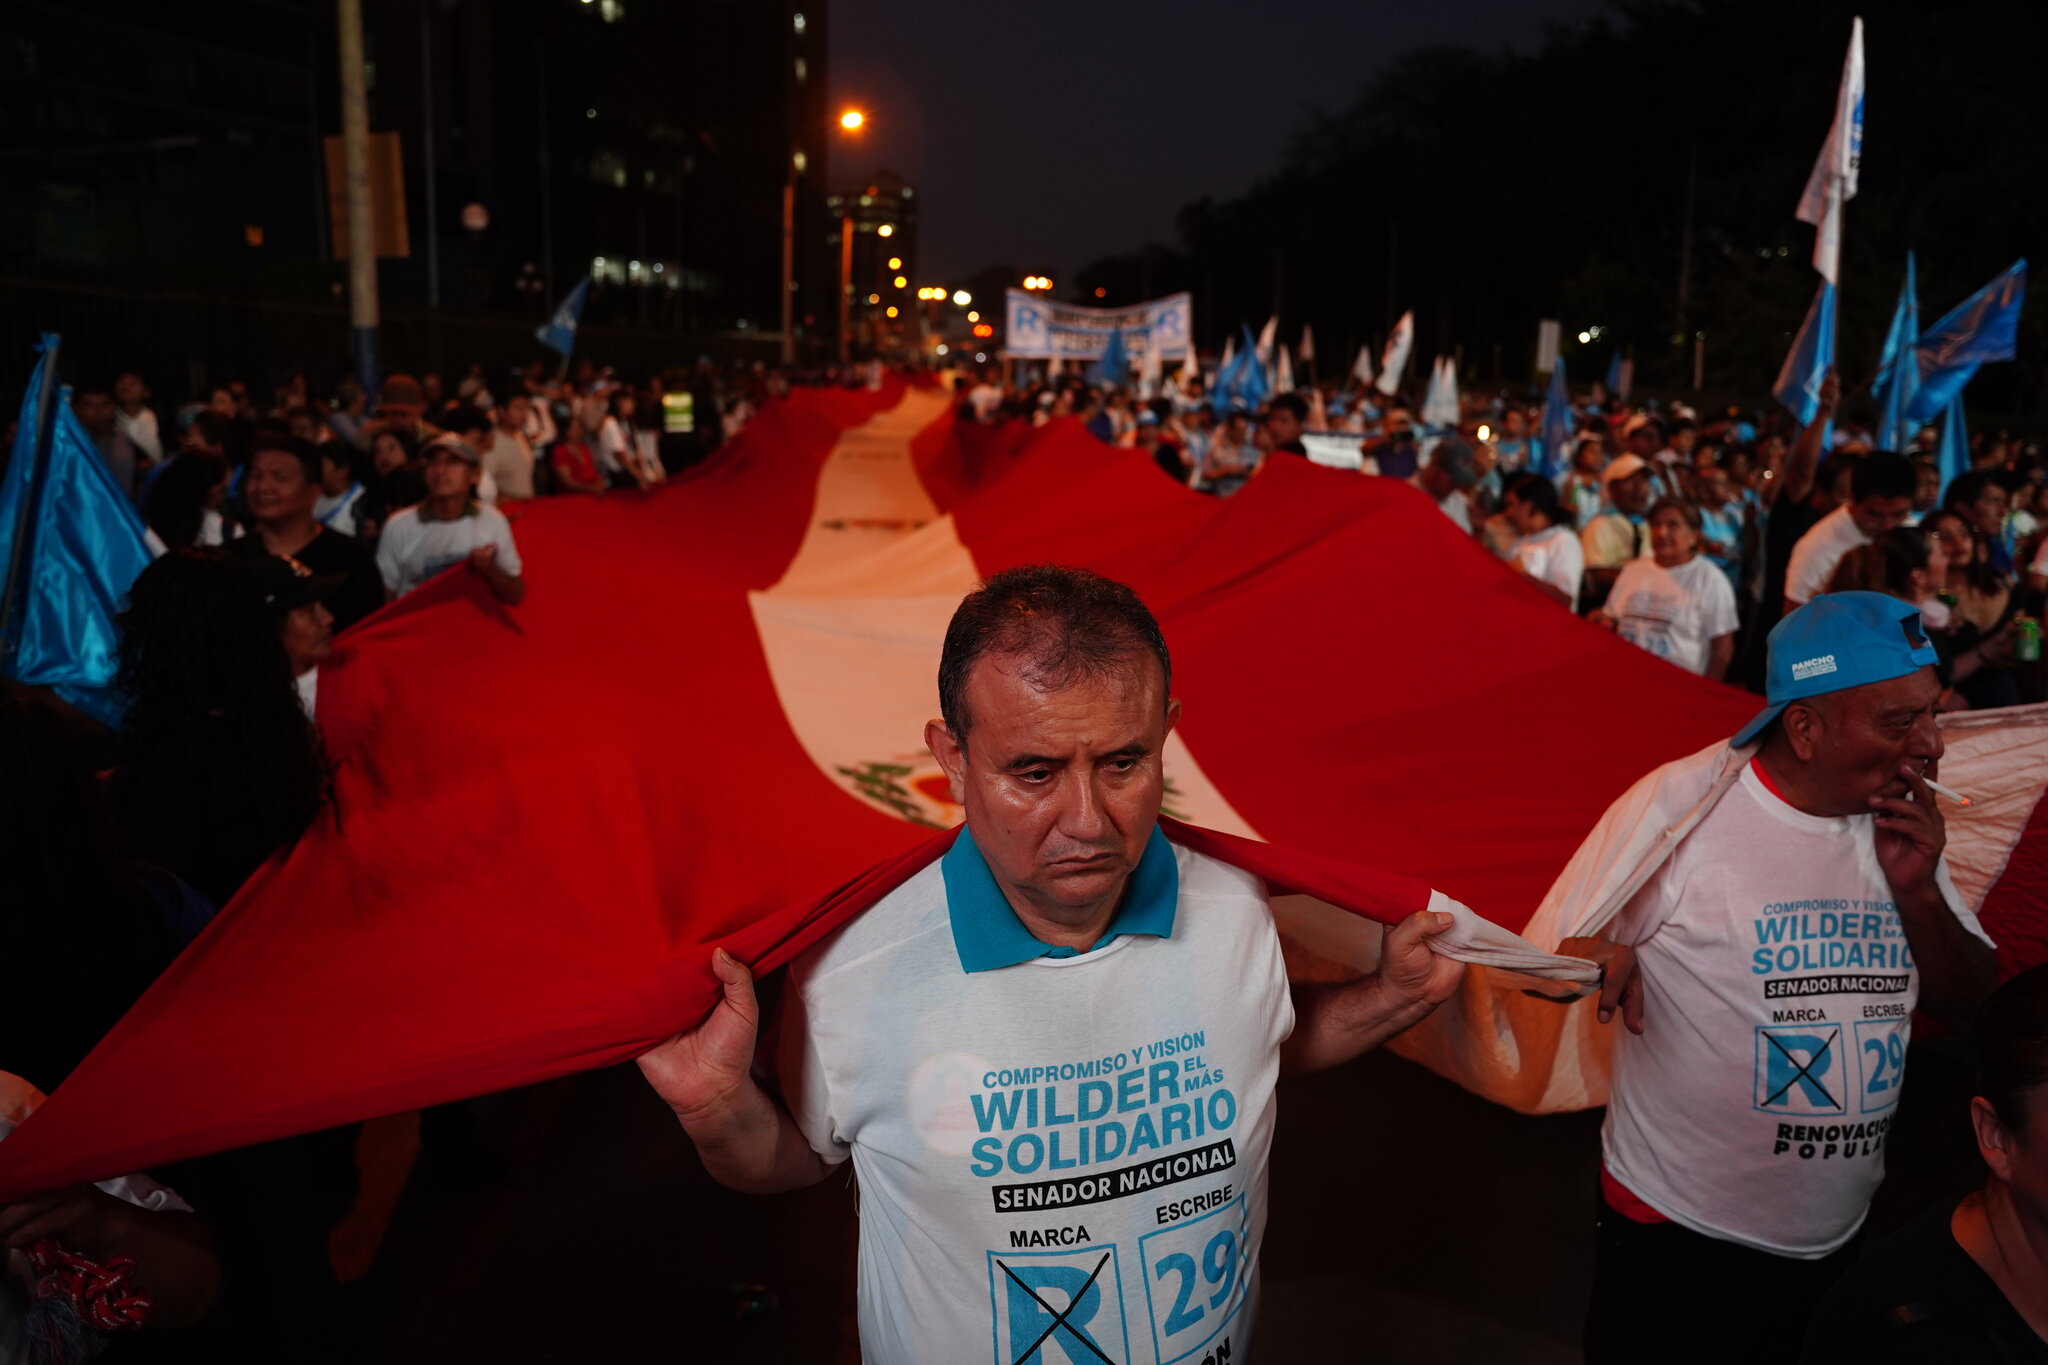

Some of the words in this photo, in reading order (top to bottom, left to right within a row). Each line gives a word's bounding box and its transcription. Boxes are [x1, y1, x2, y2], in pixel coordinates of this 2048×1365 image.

[1791, 655, 1835, 670] PANCHO
[1762, 899, 1848, 916] COMPROMISO
[1852, 900, 1861, 910] Y
[1754, 912, 1883, 945] WILDER
[1767, 977, 1839, 997] SENADOR
[1841, 977, 1907, 992] NACIONAL
[1773, 1008, 1826, 1023] MARCA
[1862, 1003, 1906, 1018] ESCRIBE
[982, 1053, 1128, 1089] COMPROMISO
[1131, 1046, 1144, 1064] Y
[1147, 1030, 1206, 1060] VISIÓN
[1184, 1055, 1206, 1072] EL
[1766, 1034, 1836, 1107] R
[1863, 1032, 1904, 1094] 29
[970, 1060, 1181, 1133] WILDER
[1184, 1069, 1224, 1093] MÁS
[970, 1088, 1237, 1178] SOLIDARIO
[998, 1177, 1111, 1209] SENADOR
[1119, 1144, 1234, 1192] NACIONAL
[1155, 1184, 1233, 1224] ESCRIBE
[1010, 1225, 1091, 1248] MARCA
[1154, 1230, 1238, 1338] 29
[1005, 1265, 1109, 1365] R
